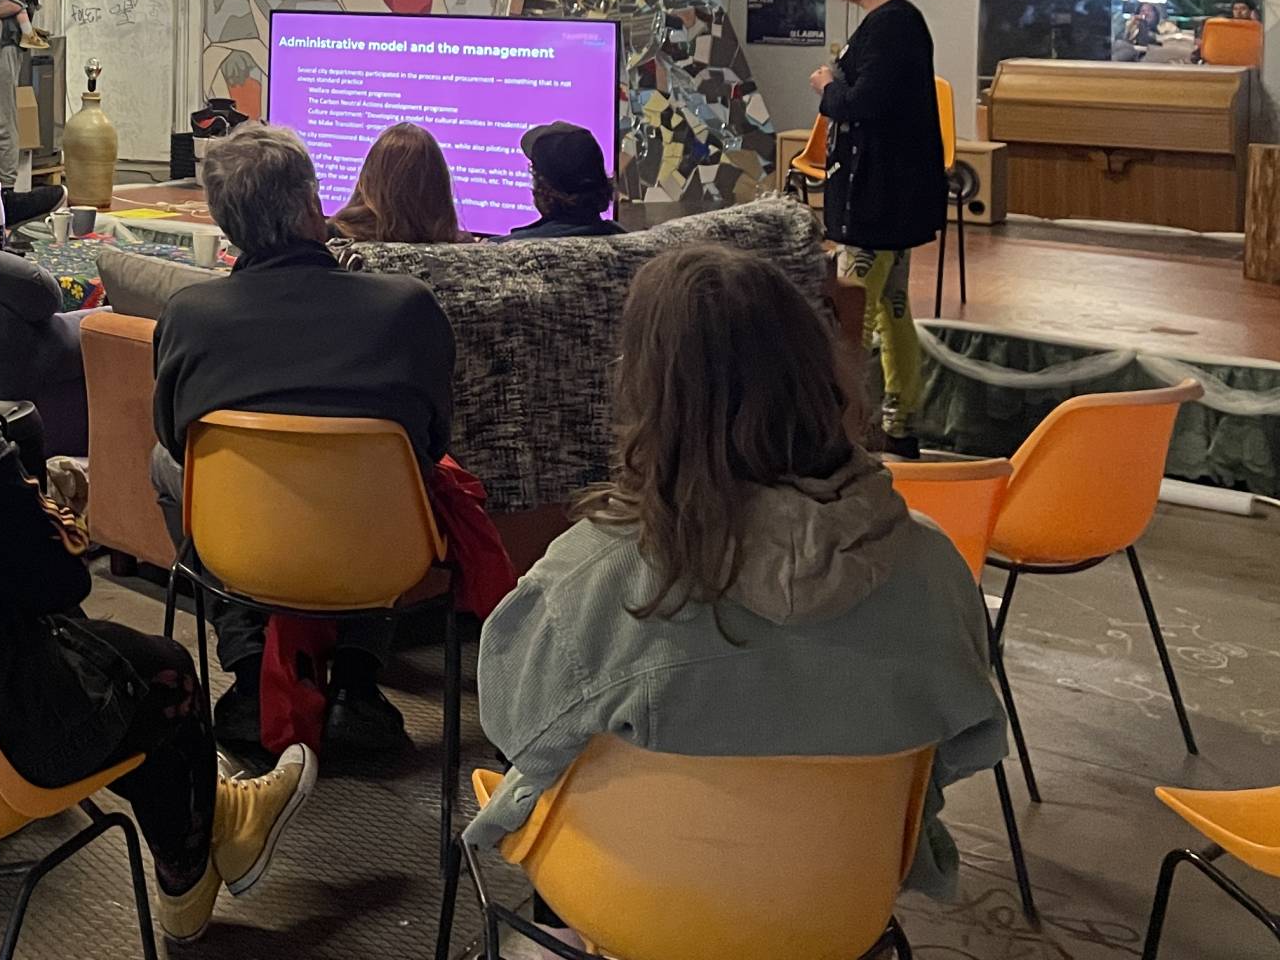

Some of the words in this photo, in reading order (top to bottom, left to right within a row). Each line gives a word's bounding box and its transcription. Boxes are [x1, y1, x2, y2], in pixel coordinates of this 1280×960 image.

[279, 36, 365, 50] Administrative
[369, 40, 407, 52] model
[410, 42, 434, 53] and
[438, 42, 459, 54] the
[463, 44, 555, 59] management
[297, 66, 317, 74] Several
[318, 67, 328, 75] city
[329, 68, 364, 77] departments
[365, 70, 399, 79] participated
[419, 73, 441, 81] process
[454, 75, 494, 84] procurement
[504, 77, 537, 87] something
[539, 78, 552, 86] that
[560, 80, 572, 88] not
[297, 75, 315, 84] always
[317, 76, 340, 84] standard
[341, 77, 363, 86] practice
[331, 87, 367, 96] development
[368, 90, 401, 99] programme
[320, 97, 339, 105] Carbon
[340, 98, 361, 107] Neutral
[362, 100, 383, 108] Actions
[384, 101, 422, 111] development
[423, 104, 458, 114] programme
[308, 107, 328, 116] Culture
[405, 113, 424, 121] model
[425, 115, 433, 123] for
[434, 116, 458, 125] cultural
[459, 118, 486, 127] activities
[487, 119, 493, 127] in
[494, 120, 527, 130] residential
[307, 131, 318, 139] city
[486, 145, 509, 154] piloting
[322, 153, 332, 161] the
[333, 155, 364, 163] agreement
[325, 163, 338, 171] right
[489, 168, 507, 176] which
[502, 178, 513, 186] The
[461, 198, 489, 208] although
[489, 200, 500, 208] the
